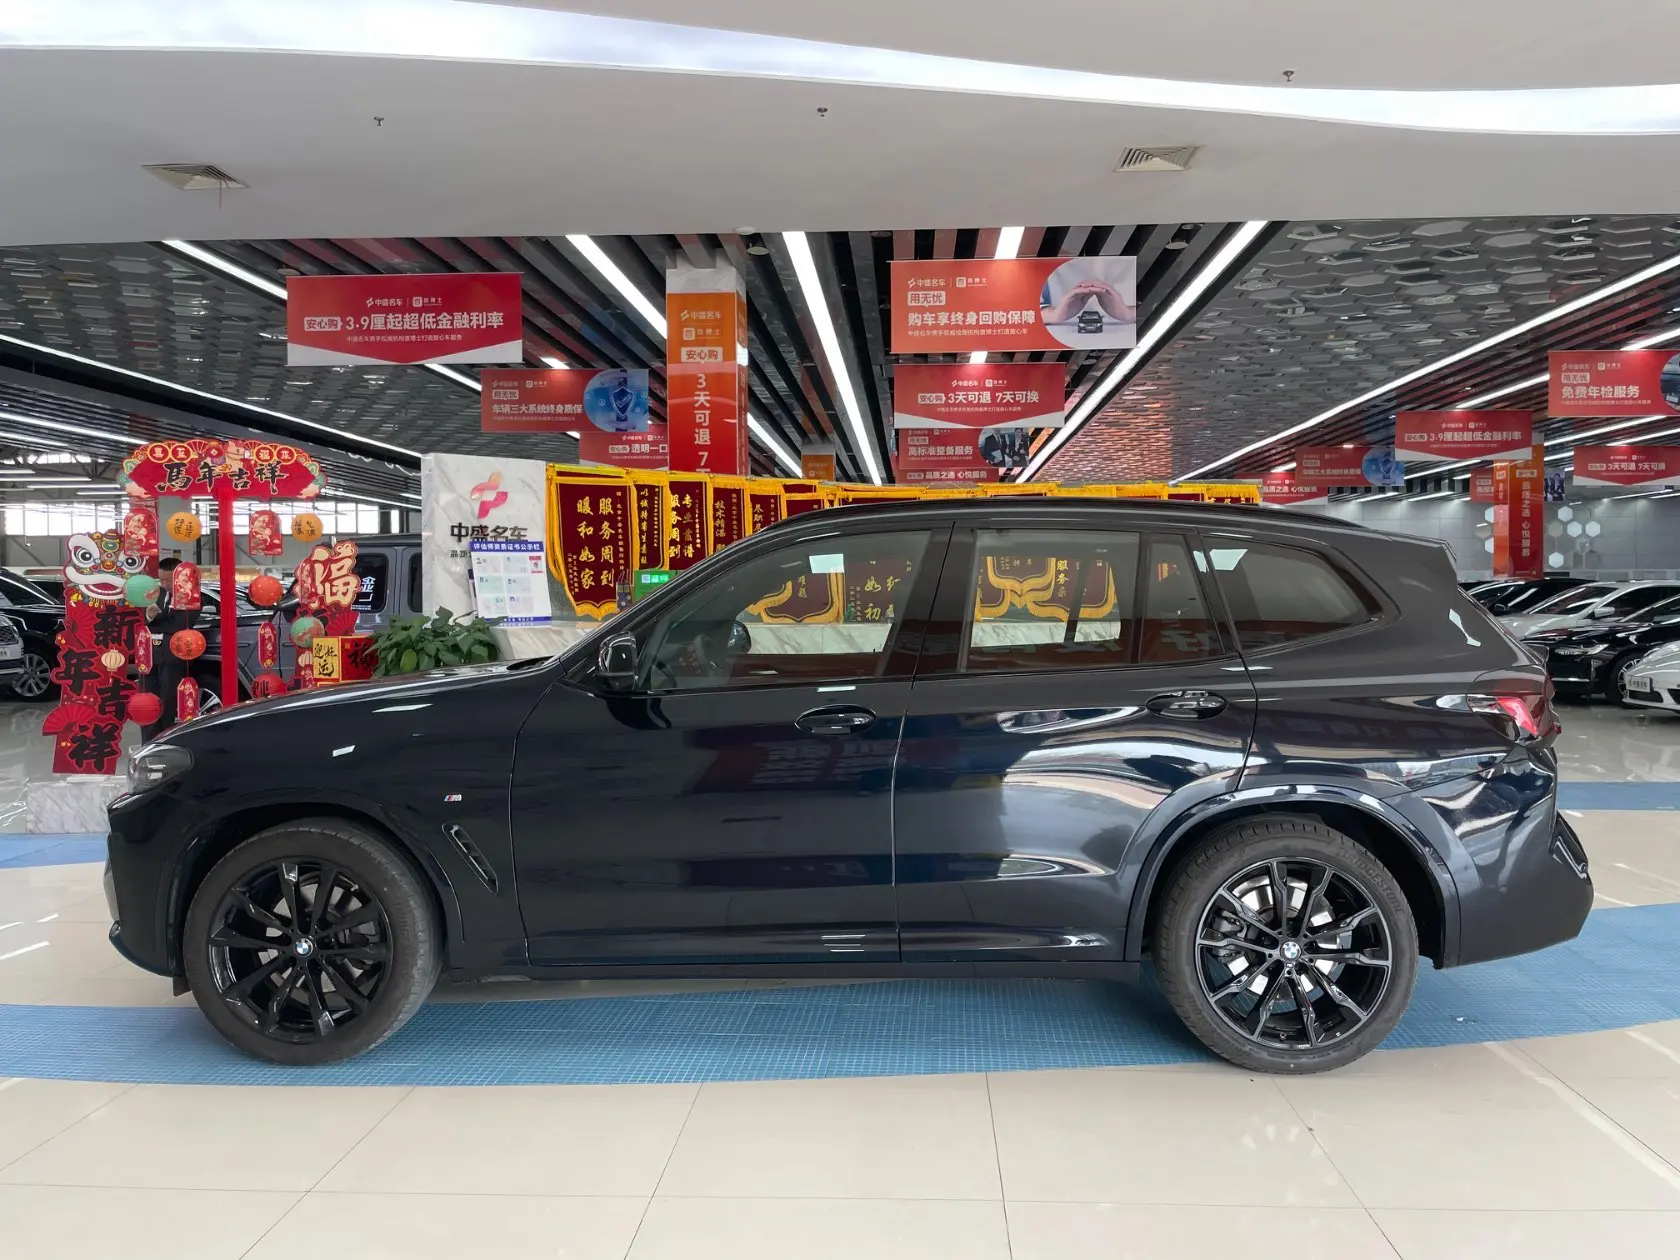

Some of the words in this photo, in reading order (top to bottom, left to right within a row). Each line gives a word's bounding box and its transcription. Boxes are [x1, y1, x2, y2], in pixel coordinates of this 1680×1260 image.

[910, 292, 944, 304] 用无忧
[306, 318, 338, 330] 安心购
[346, 312, 504, 330] 3.9厘起超低金融利率
[908, 310, 1036, 326] 购车享终身回购保障
[686, 350, 718, 360] 安心购
[948, 392, 992, 404] 3天可退
[996, 391, 1039, 404] 7天可换
[1562, 385, 1640, 399] 免费年检服务
[492, 404, 583, 414] 车辆三大系统终身质保
[694, 374, 712, 445] 3天可退
[156, 460, 289, 494] 馬年吉祥
[450, 522, 528, 542] 中盛名车
[576, 496, 596, 590] 暖和如家
[598, 497, 616, 588] 服务周到
[312, 543, 359, 606] 福
[55, 605, 139, 772] 新年吉祥
